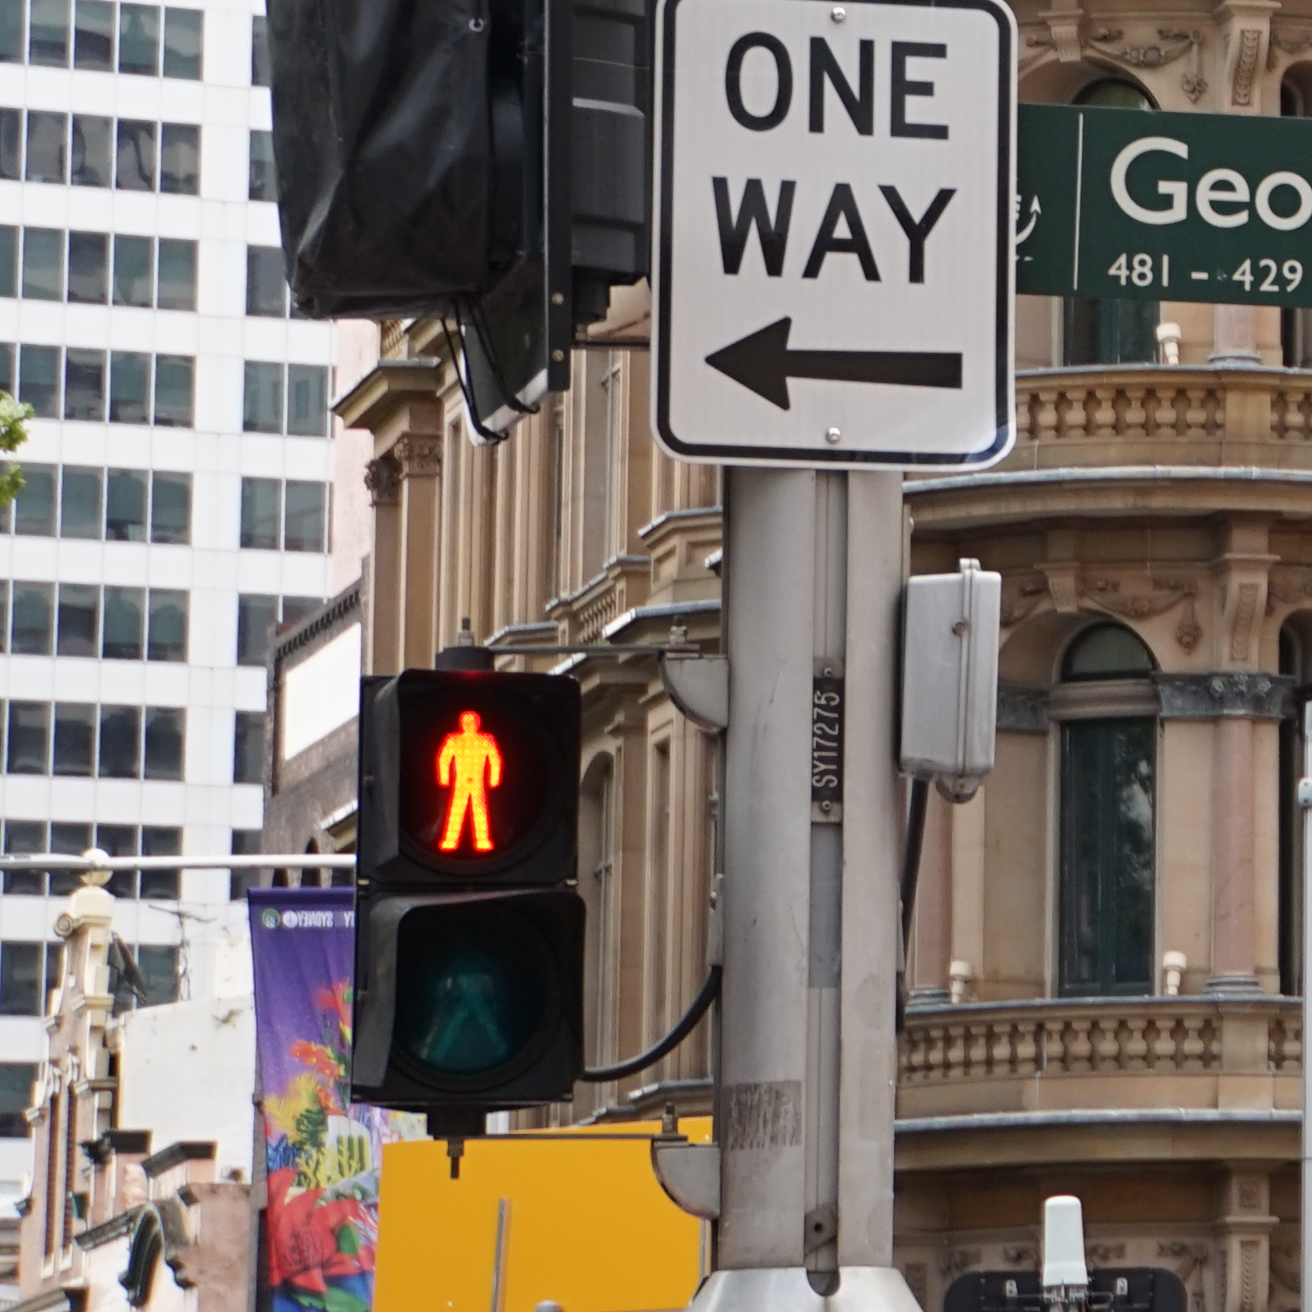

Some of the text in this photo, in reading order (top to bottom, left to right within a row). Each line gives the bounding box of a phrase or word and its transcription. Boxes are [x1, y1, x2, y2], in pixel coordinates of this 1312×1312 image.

[725, 31, 950, 140] ONE
[711, 176, 958, 284] WAY
[1108, 253, 1170, 288] 481
[1231, 257, 1304, 293] 429
[812, 690, 841, 788] SY17275
